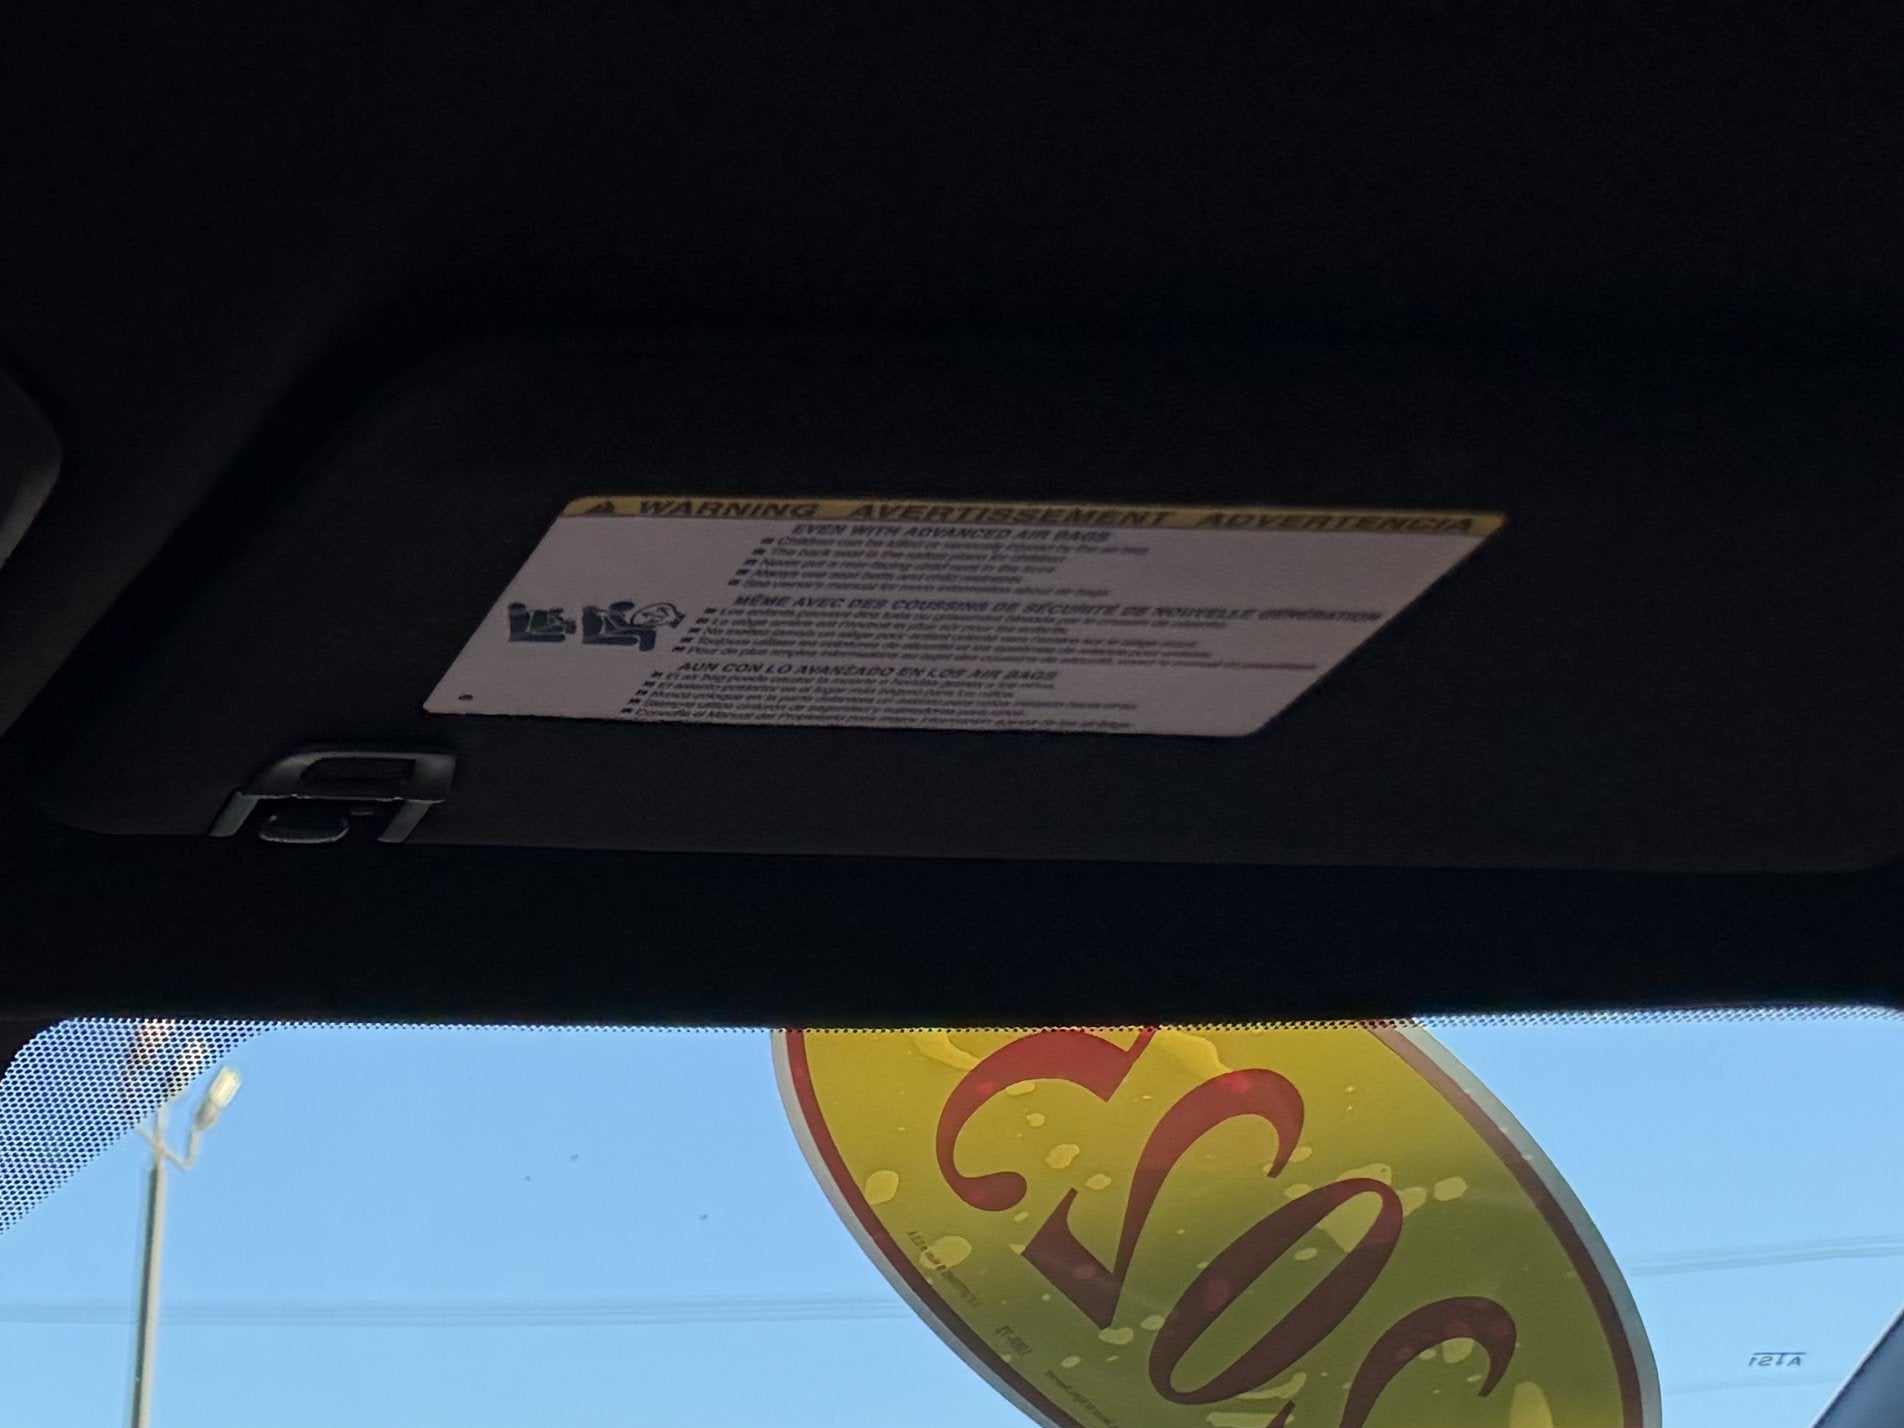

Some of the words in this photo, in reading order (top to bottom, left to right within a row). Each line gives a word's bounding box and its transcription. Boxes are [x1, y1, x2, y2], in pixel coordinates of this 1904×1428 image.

[641, 501, 820, 518] WARNING
[847, 503, 1173, 527] AVERTISSEMENT
[1197, 512, 1473, 533] ADVERTENCIA
[792, 524, 848, 536] EVEN
[850, 525, 898, 537] WITH
[904, 526, 1011, 539] ADVANCED
[1017, 528, 1050, 540] AIR
[1053, 530, 1111, 541] BAGS
[792, 597, 842, 608] AVEC
[846, 599, 888, 610] DES
[891, 600, 989, 612] COUSSINS
[678, 661, 717, 672] AUN
[721, 662, 765, 673] CON
[765, 664, 793, 674] LO
[796, 665, 895, 677] AVANZADO
